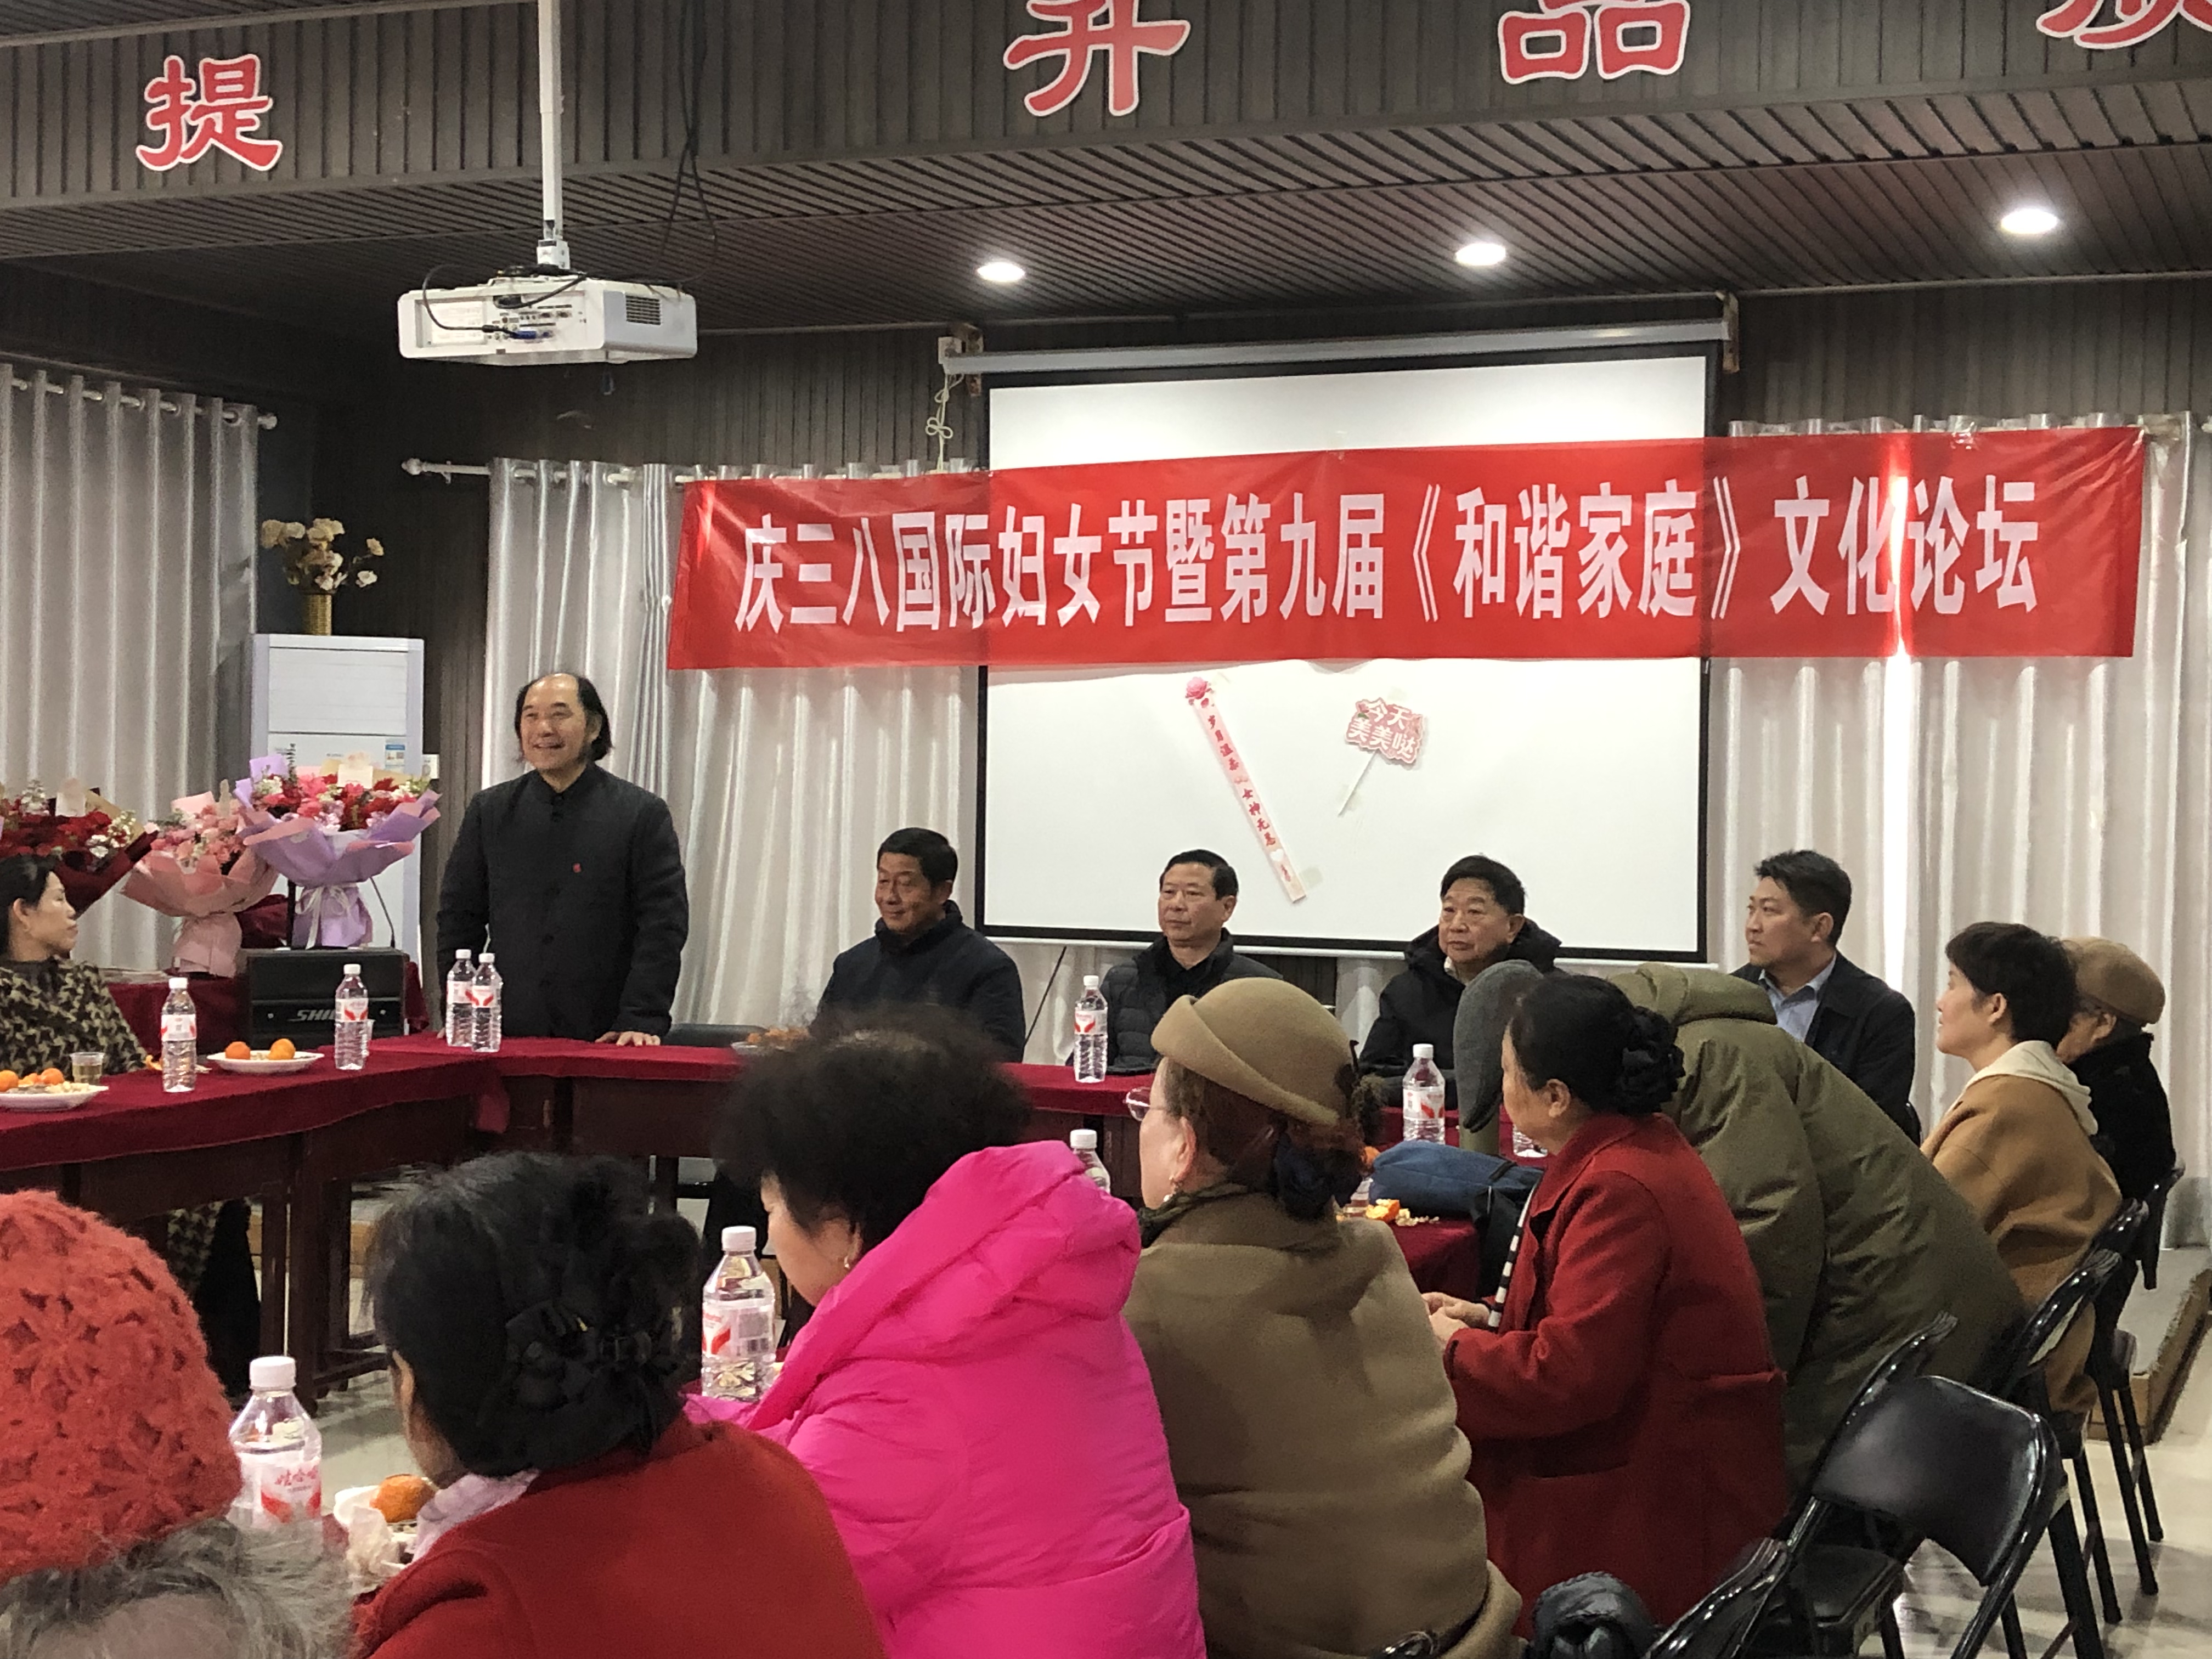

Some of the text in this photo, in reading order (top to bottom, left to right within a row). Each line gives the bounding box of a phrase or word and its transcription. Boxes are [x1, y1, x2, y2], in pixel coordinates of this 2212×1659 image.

[136, 53, 283, 172] 提
[1498, 0, 1690, 84] 品
[1367, 699, 1410, 730] 今天
[1348, 718, 1416, 759] 美美哒
